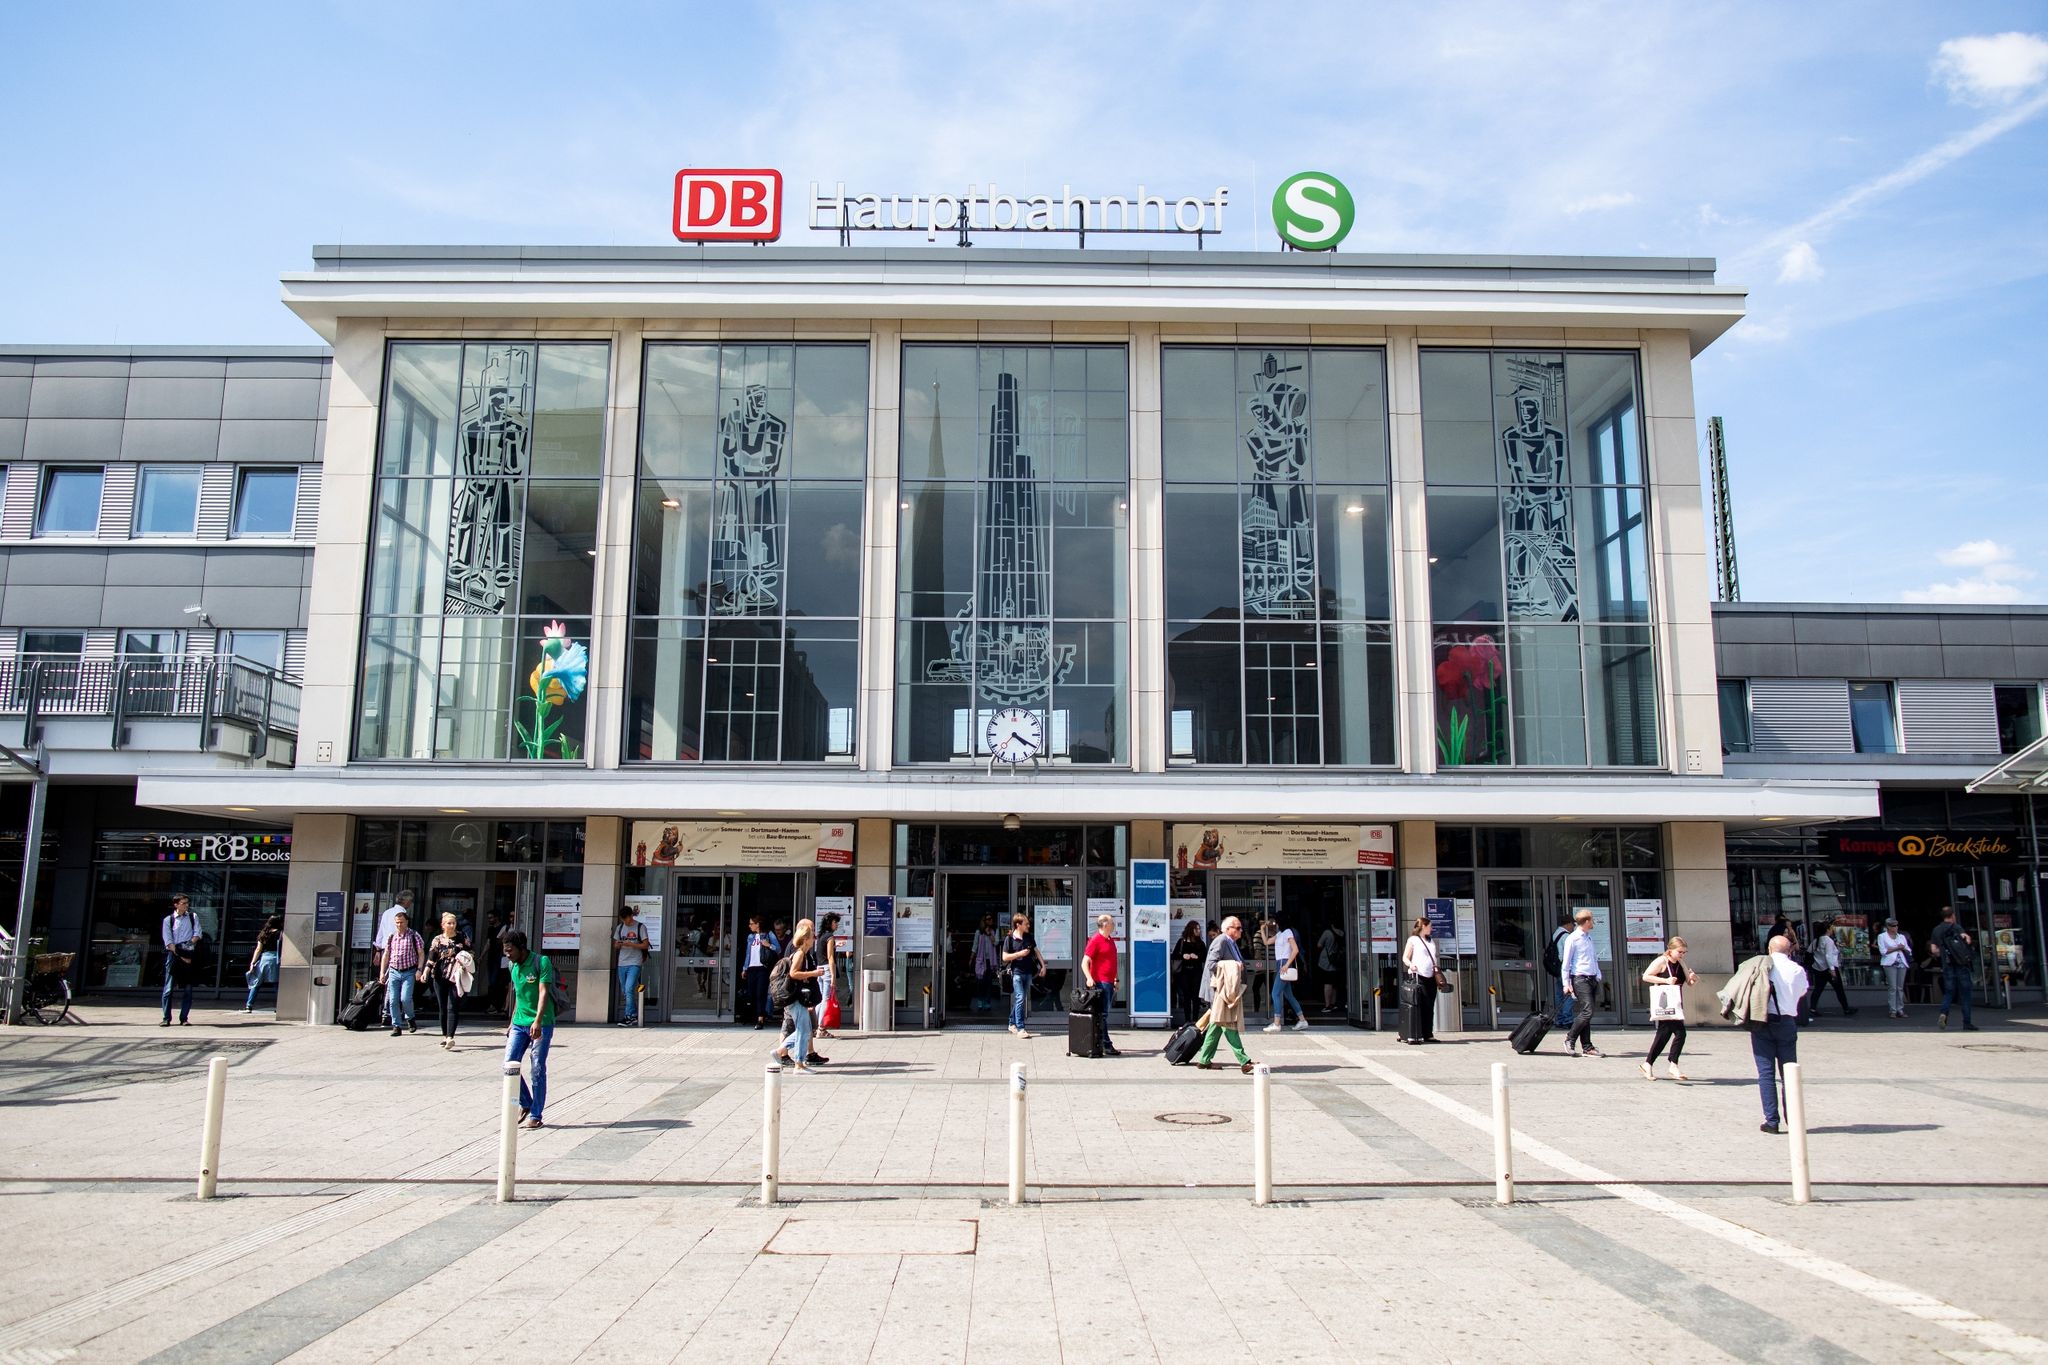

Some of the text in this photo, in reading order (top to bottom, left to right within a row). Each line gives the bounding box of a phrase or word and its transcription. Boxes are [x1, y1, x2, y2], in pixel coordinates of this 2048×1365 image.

[687, 181, 767, 227] DB
[809, 181, 1228, 242] Hauptbahnhof
[1286, 178, 1341, 242] S
[832, 829, 843, 837] DB
[1371, 830, 1382, 838] DB
[160, 834, 290, 861] Press P&B Books
[1840, 835, 2010, 860] Kamps Backstube
